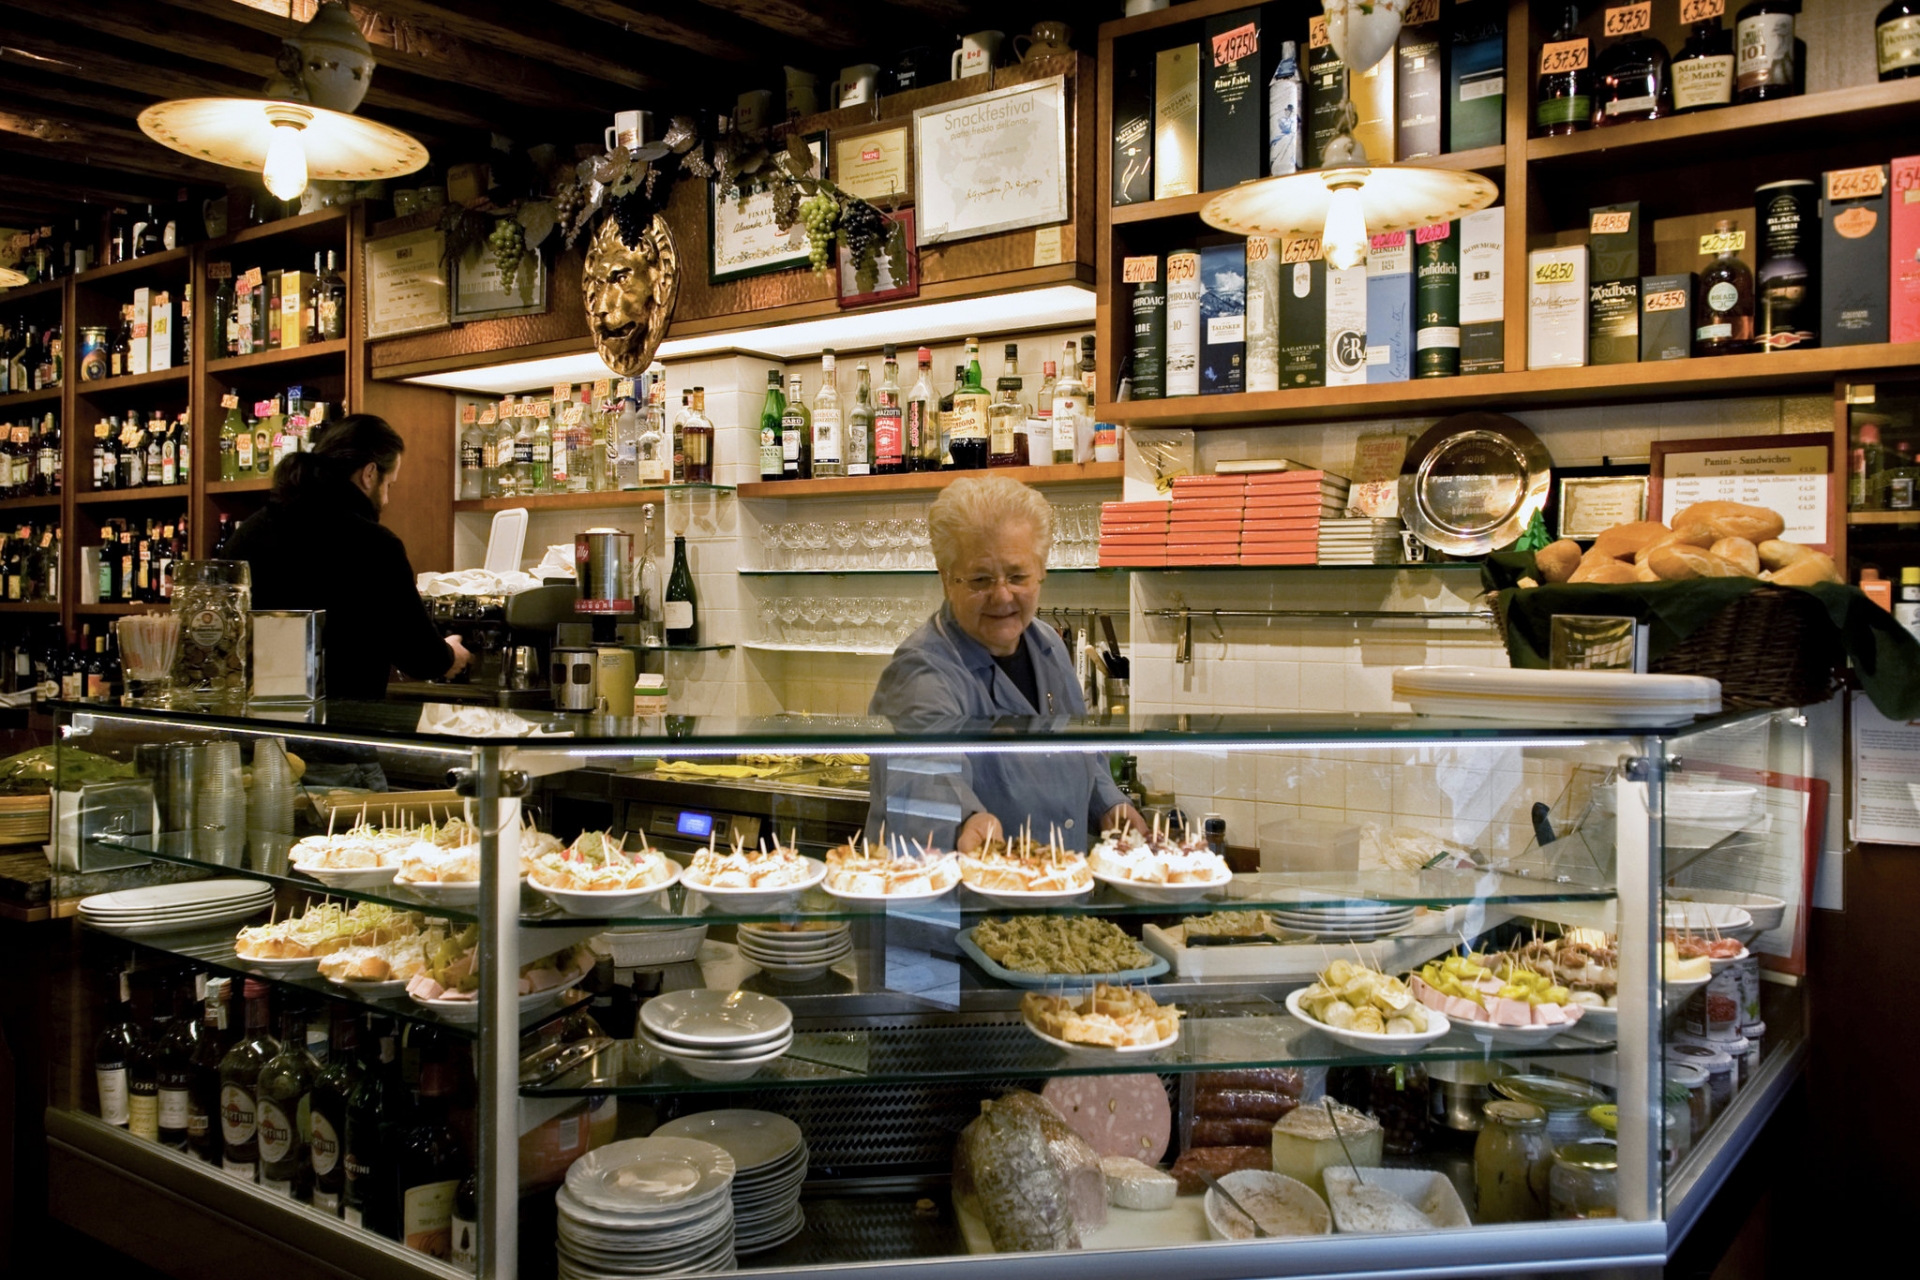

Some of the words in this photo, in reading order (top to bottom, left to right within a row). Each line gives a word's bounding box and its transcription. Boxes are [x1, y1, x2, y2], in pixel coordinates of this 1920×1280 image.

[1742, 45, 1766, 62] 101
[1678, 61, 1727, 74] Maker's
[1692, 70, 1725, 80] Mark
[945, 94, 1035, 131] Snackfestival
[972, 125, 994, 136] freddo
[1116, 129, 1132, 142] BLACK
[1132, 119, 1149, 132] LABEL
[1767, 215, 1800, 225] BLACK
[1770, 223, 1798, 232] BUSH
[1463, 242, 1501, 255] BOWMORE
[1418, 262, 1458, 278] Glenfiddich
[1133, 296, 1165, 308] PHROAIG
[1168, 291, 1200, 303] PHROAIG
[1428, 313, 1438, 323] 12
[1135, 323, 1150, 333] LORE
[1173, 319, 1182, 331] 10
[1704, 457, 1732, 466] Panini
[1739, 455, 1792, 465] Sandwiches
[577, 545, 589, 560] illy
[258, 1121, 288, 1141] ARTINI
